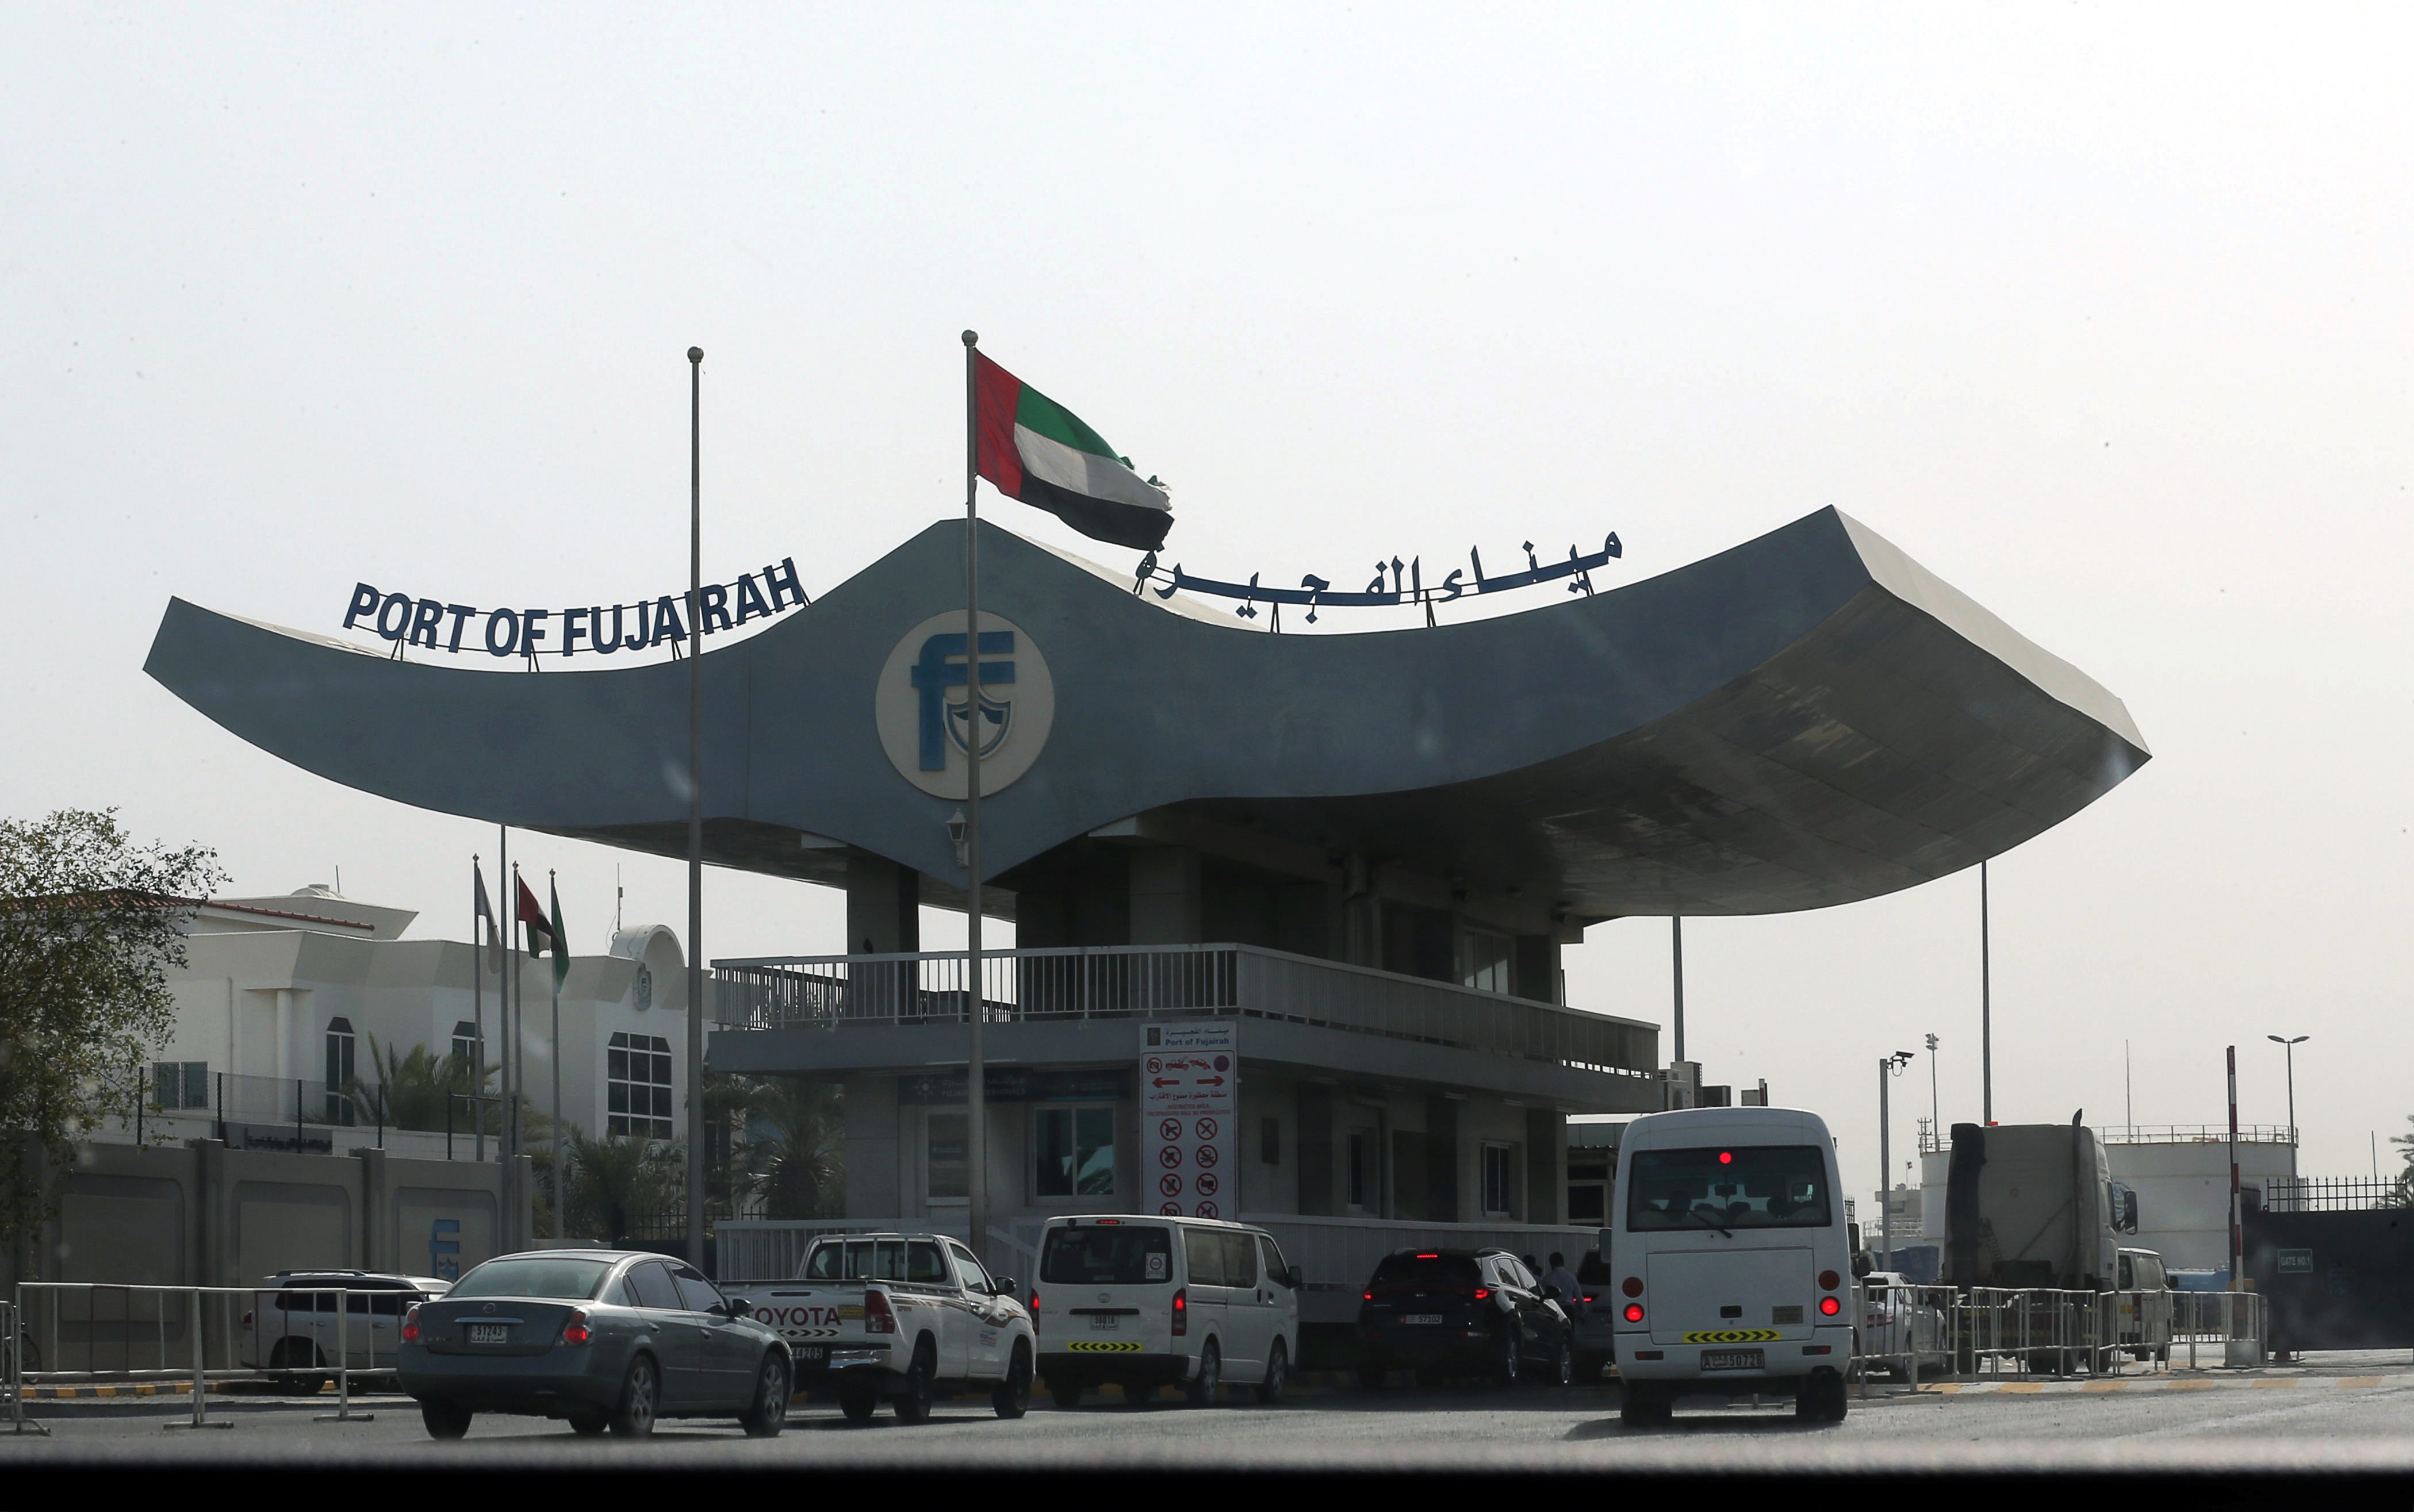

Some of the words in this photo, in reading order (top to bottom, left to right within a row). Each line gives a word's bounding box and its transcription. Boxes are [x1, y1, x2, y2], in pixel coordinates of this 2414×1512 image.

[1438, 531, 1622, 603] ميناء
[1136, 542, 1420, 624] الفجيرة
[343, 582, 477, 653] PORT
[485, 608, 548, 657] OF
[1196, 1037, 1229, 1046] Fujairah
[2281, 1256, 2296, 1266] GATE
[747, 1307, 842, 1326] OYOTA
[477, 1325, 502, 1336] 51243
[1704, 1356, 1711, 1368] A
